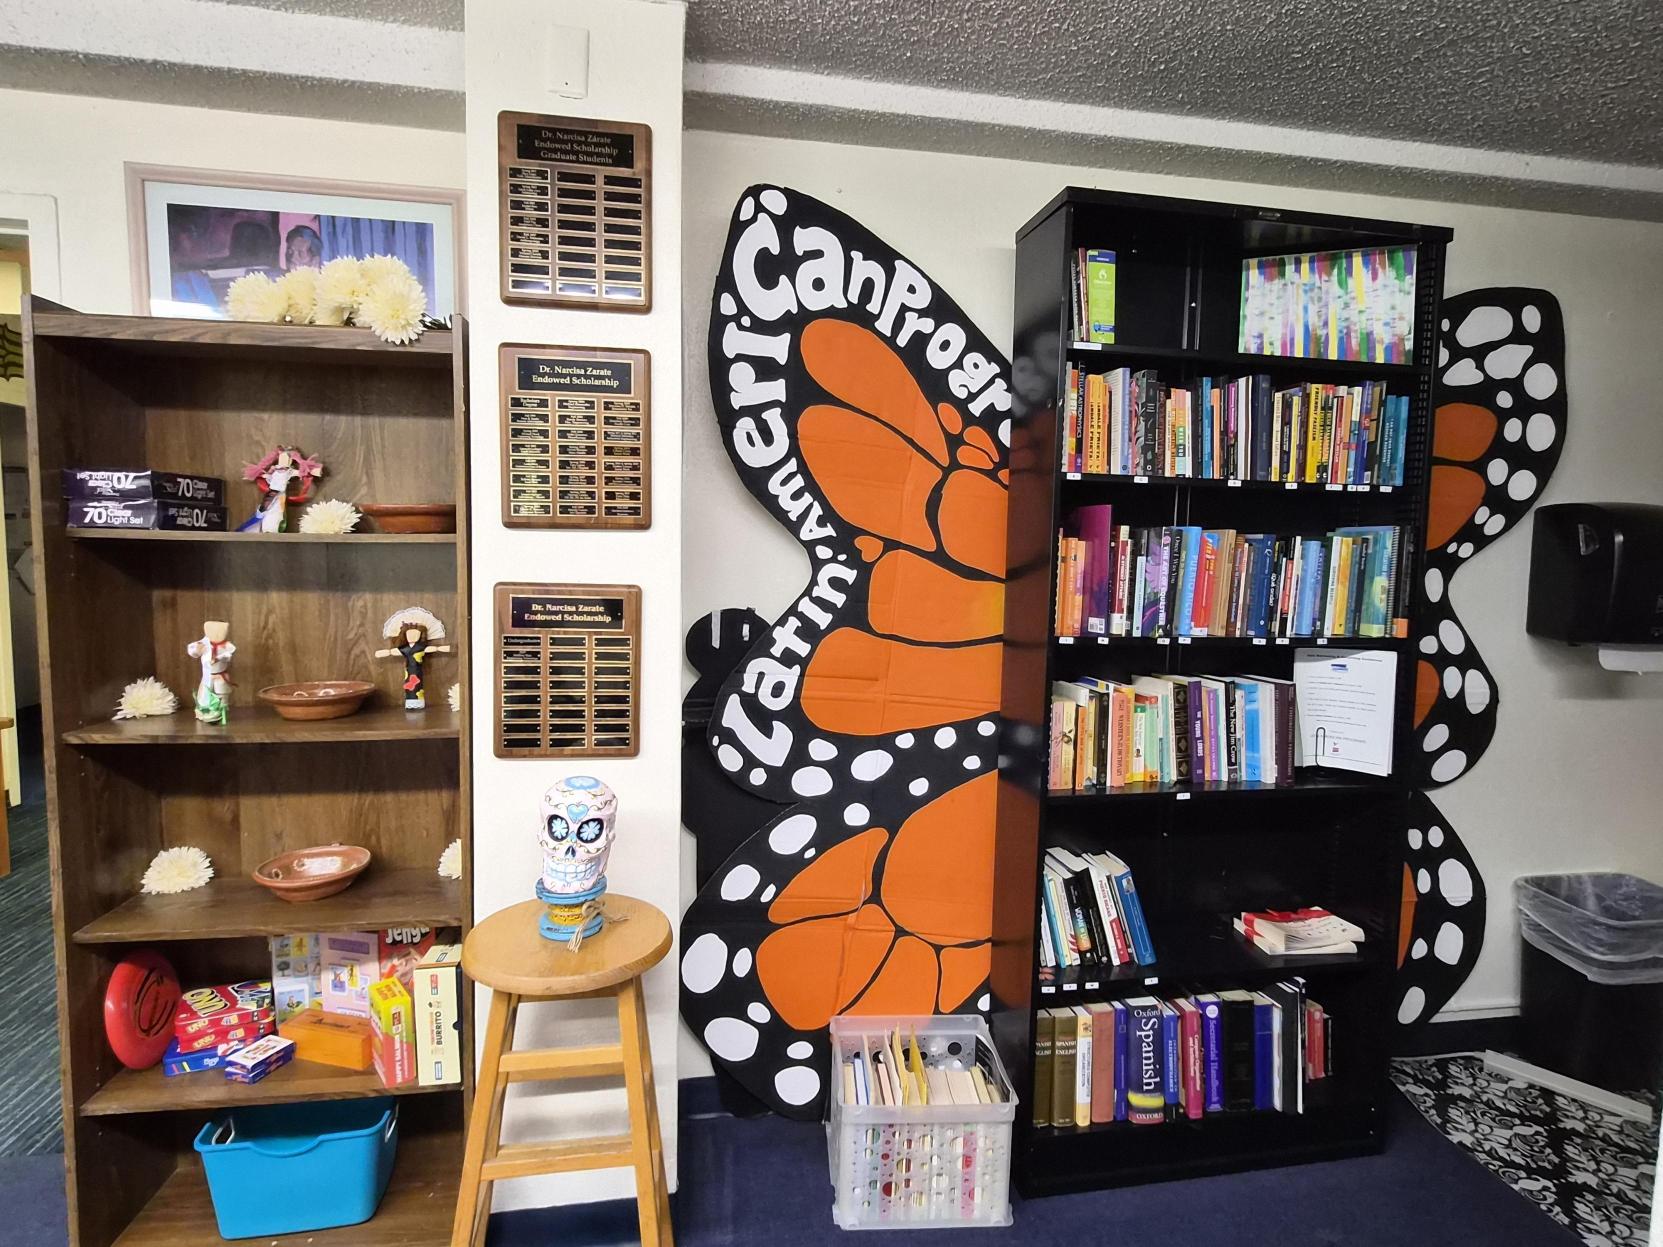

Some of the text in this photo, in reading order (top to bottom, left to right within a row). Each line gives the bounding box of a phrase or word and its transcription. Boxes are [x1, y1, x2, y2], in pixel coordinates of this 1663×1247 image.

[541, 129, 555, 139] Dr.
[556, 132, 585, 143] Narcisa
[534, 139, 619, 156] Endowed Scholarship
[540, 151, 613, 164] Graduate Students
[539, 364, 612, 376] Dr. Narcisa Zarate
[532, 374, 619, 388] Endowed Scholarship
[113, 473, 137, 489] 70
[176, 478, 193, 498] 70
[83, 507, 107, 524] 70
[107, 516, 144, 525] Light Set
[193, 508, 208, 527] 70
[531, 603, 605, 612] Dr. Narcisa Zarate
[524, 613, 612, 623] Endowed Scholarship
[1229, 734, 1237, 745] Jim
[1134, 1008, 1161, 1018] Oxford
[434, 1011, 443, 1046] BURRITO
[1136, 1017, 1160, 1091] Spanish
[1208, 1019, 1220, 1102] Secretarial Handbook
